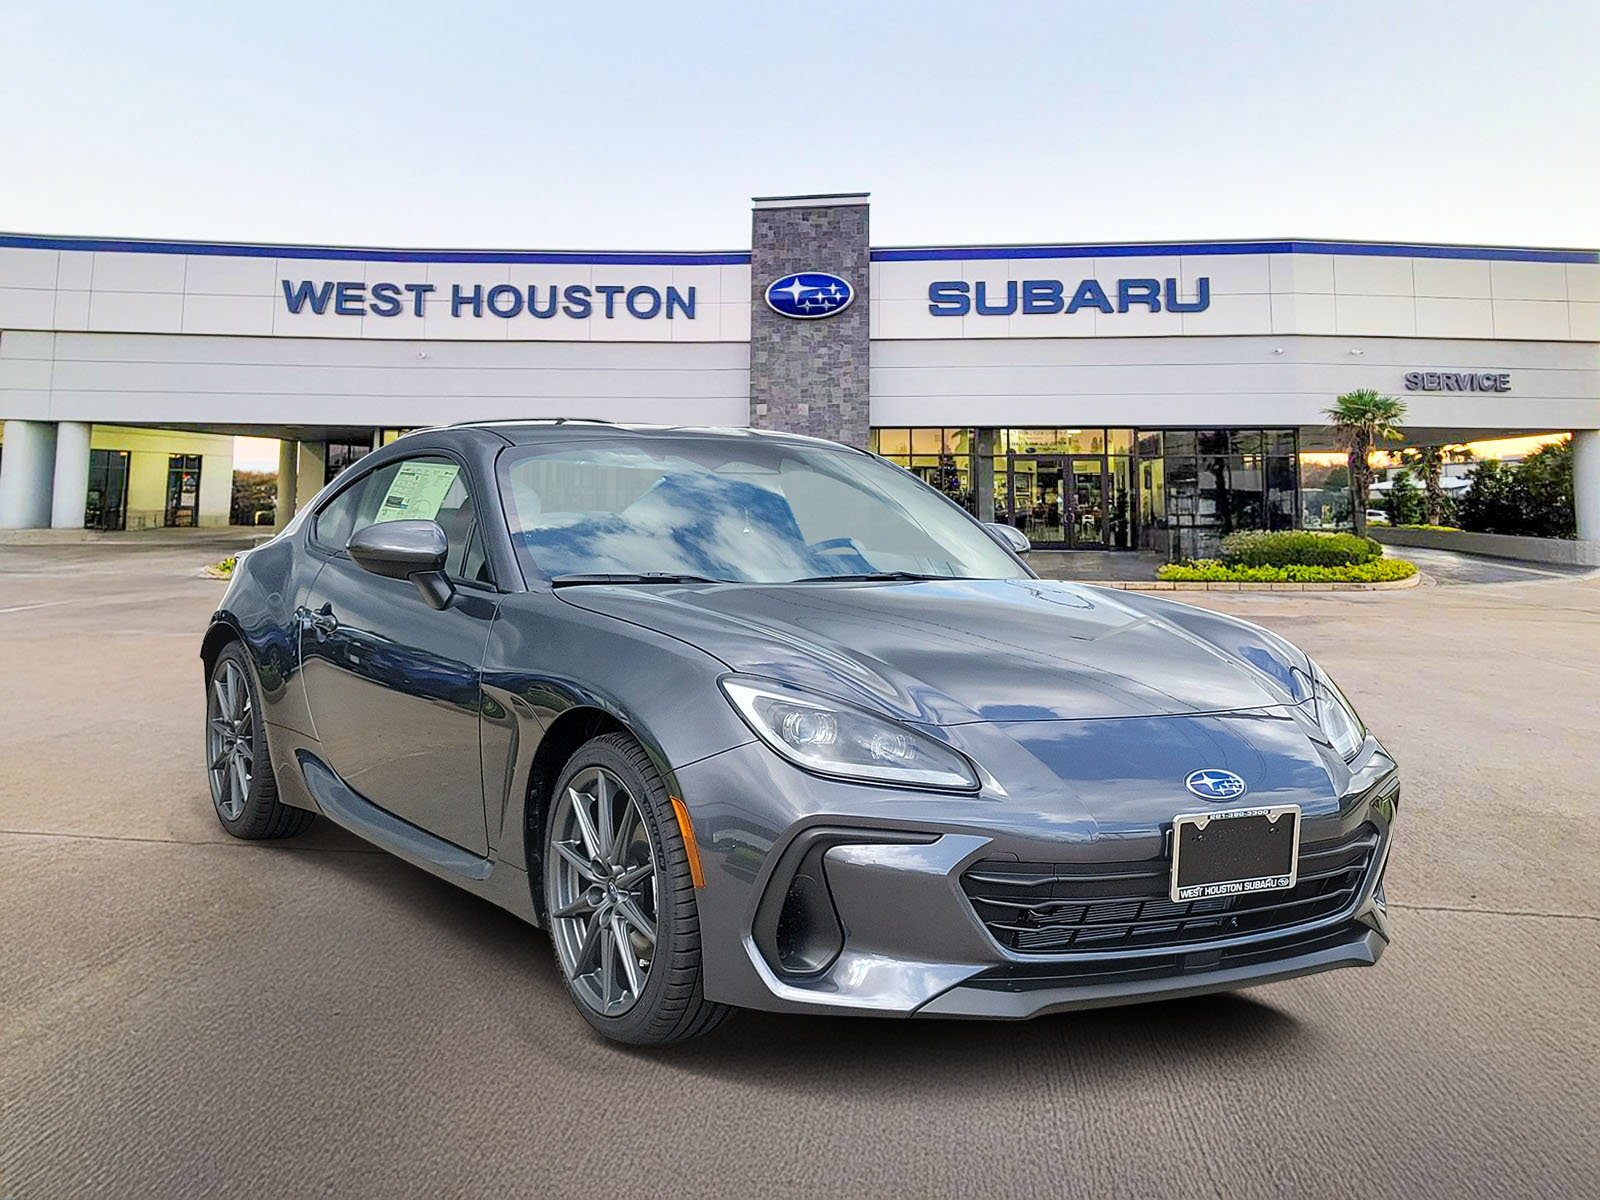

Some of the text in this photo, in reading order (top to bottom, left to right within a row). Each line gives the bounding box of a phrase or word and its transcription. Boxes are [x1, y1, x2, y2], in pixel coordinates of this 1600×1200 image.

[282, 279, 696, 320] WEST HOUSTON
[928, 277, 1210, 316] SUBARU
[1405, 371, 1511, 392] SERVICE
[1180, 878, 1277, 899] WEST HOUSTON SUBARU
